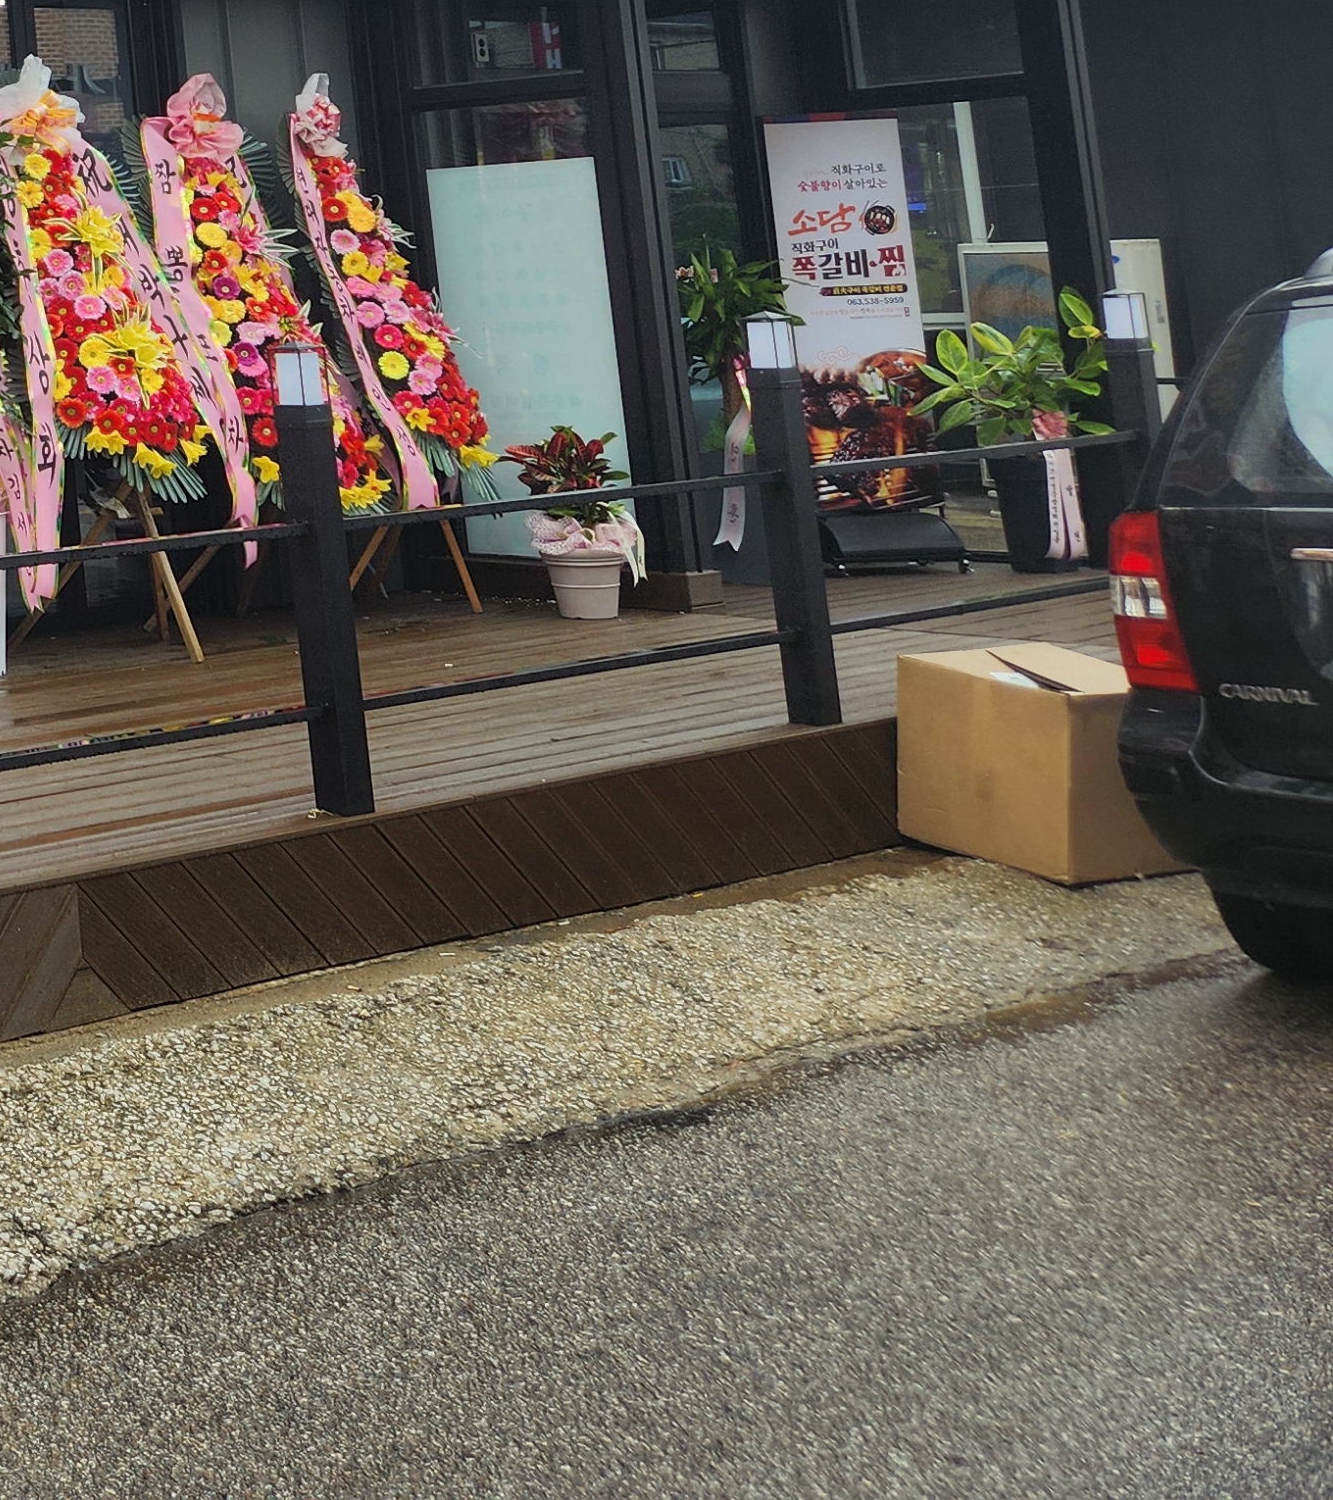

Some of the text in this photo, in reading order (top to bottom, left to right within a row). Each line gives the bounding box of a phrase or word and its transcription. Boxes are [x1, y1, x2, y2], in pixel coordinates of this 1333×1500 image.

[787, 202, 856, 236] 소담
[791, 238, 839, 254] 직화구이
[1218, 683, 1320, 706] CARNIVAL
